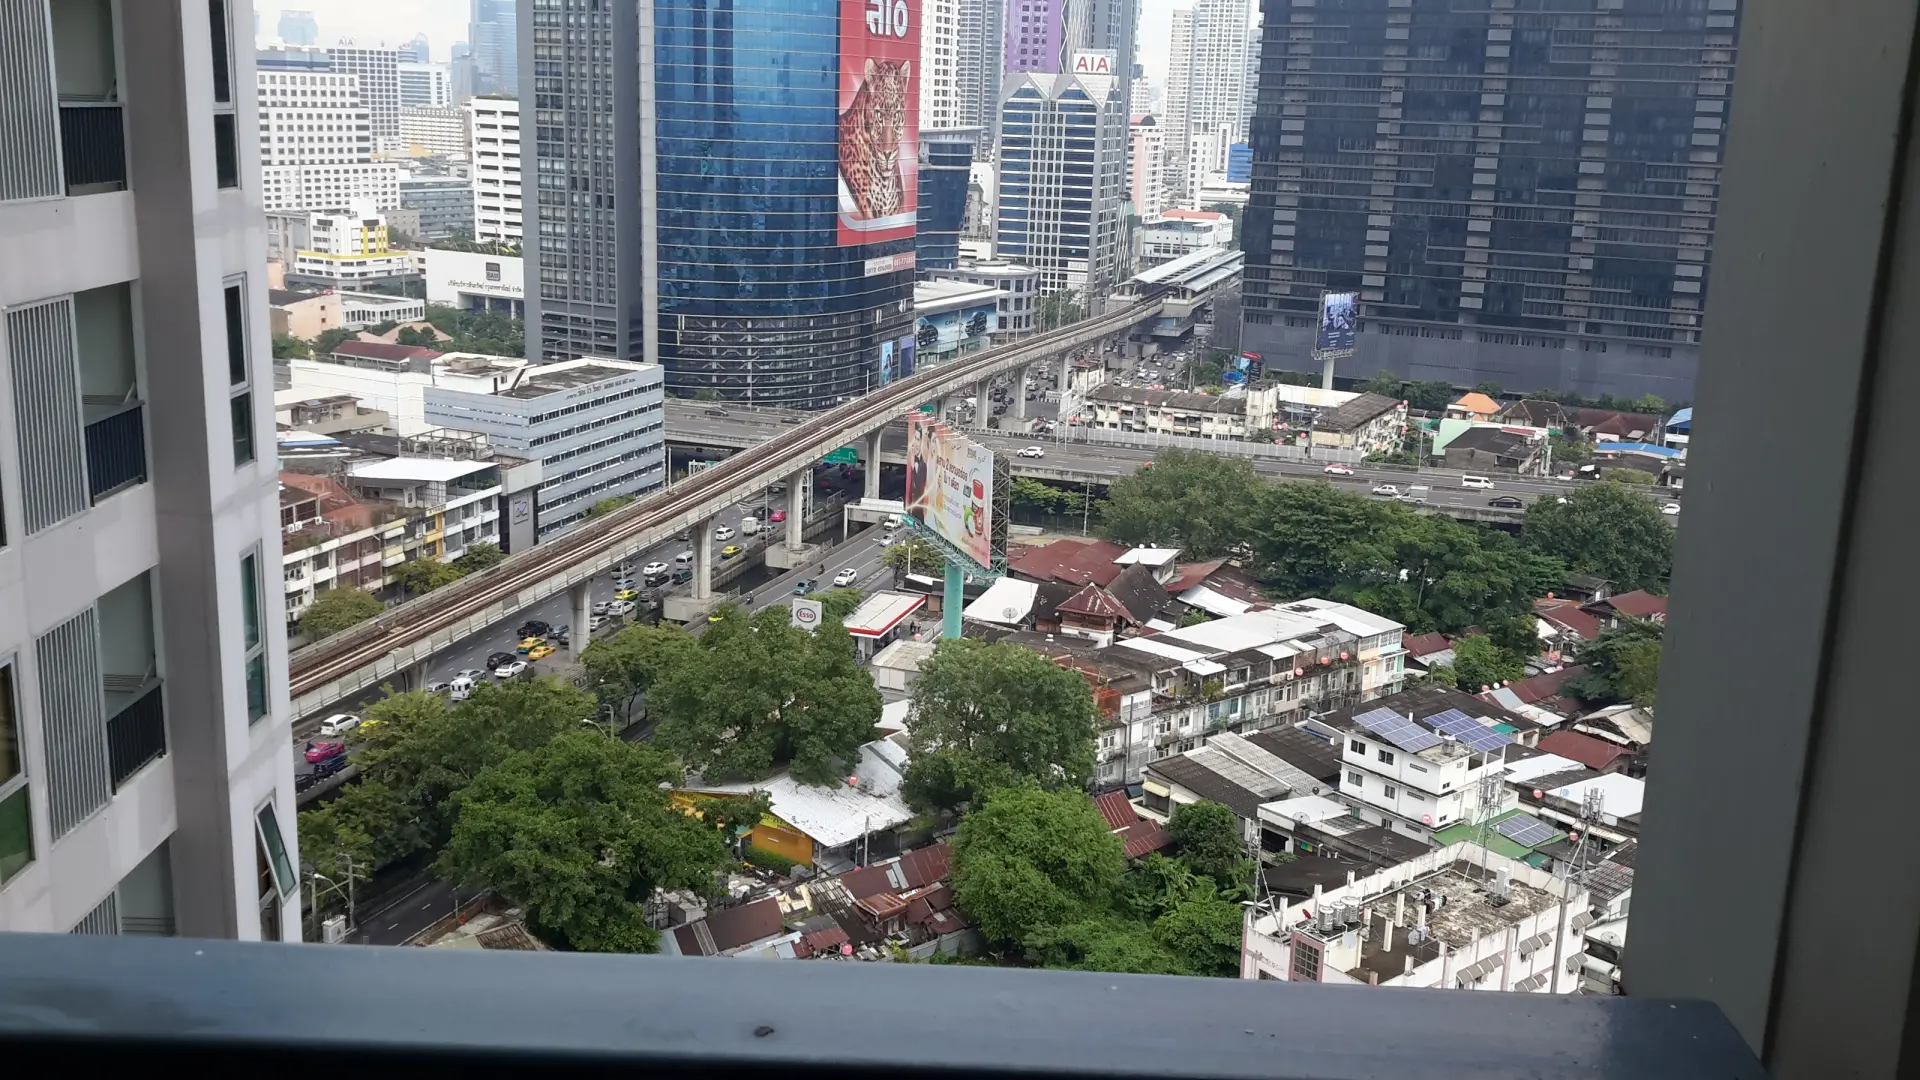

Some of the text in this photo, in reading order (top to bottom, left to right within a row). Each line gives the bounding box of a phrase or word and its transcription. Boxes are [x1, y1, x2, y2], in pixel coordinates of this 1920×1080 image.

[339, 38, 353, 46] AIA
[1076, 56, 1108, 72] AIA
[800, 611, 814, 619] Esso
